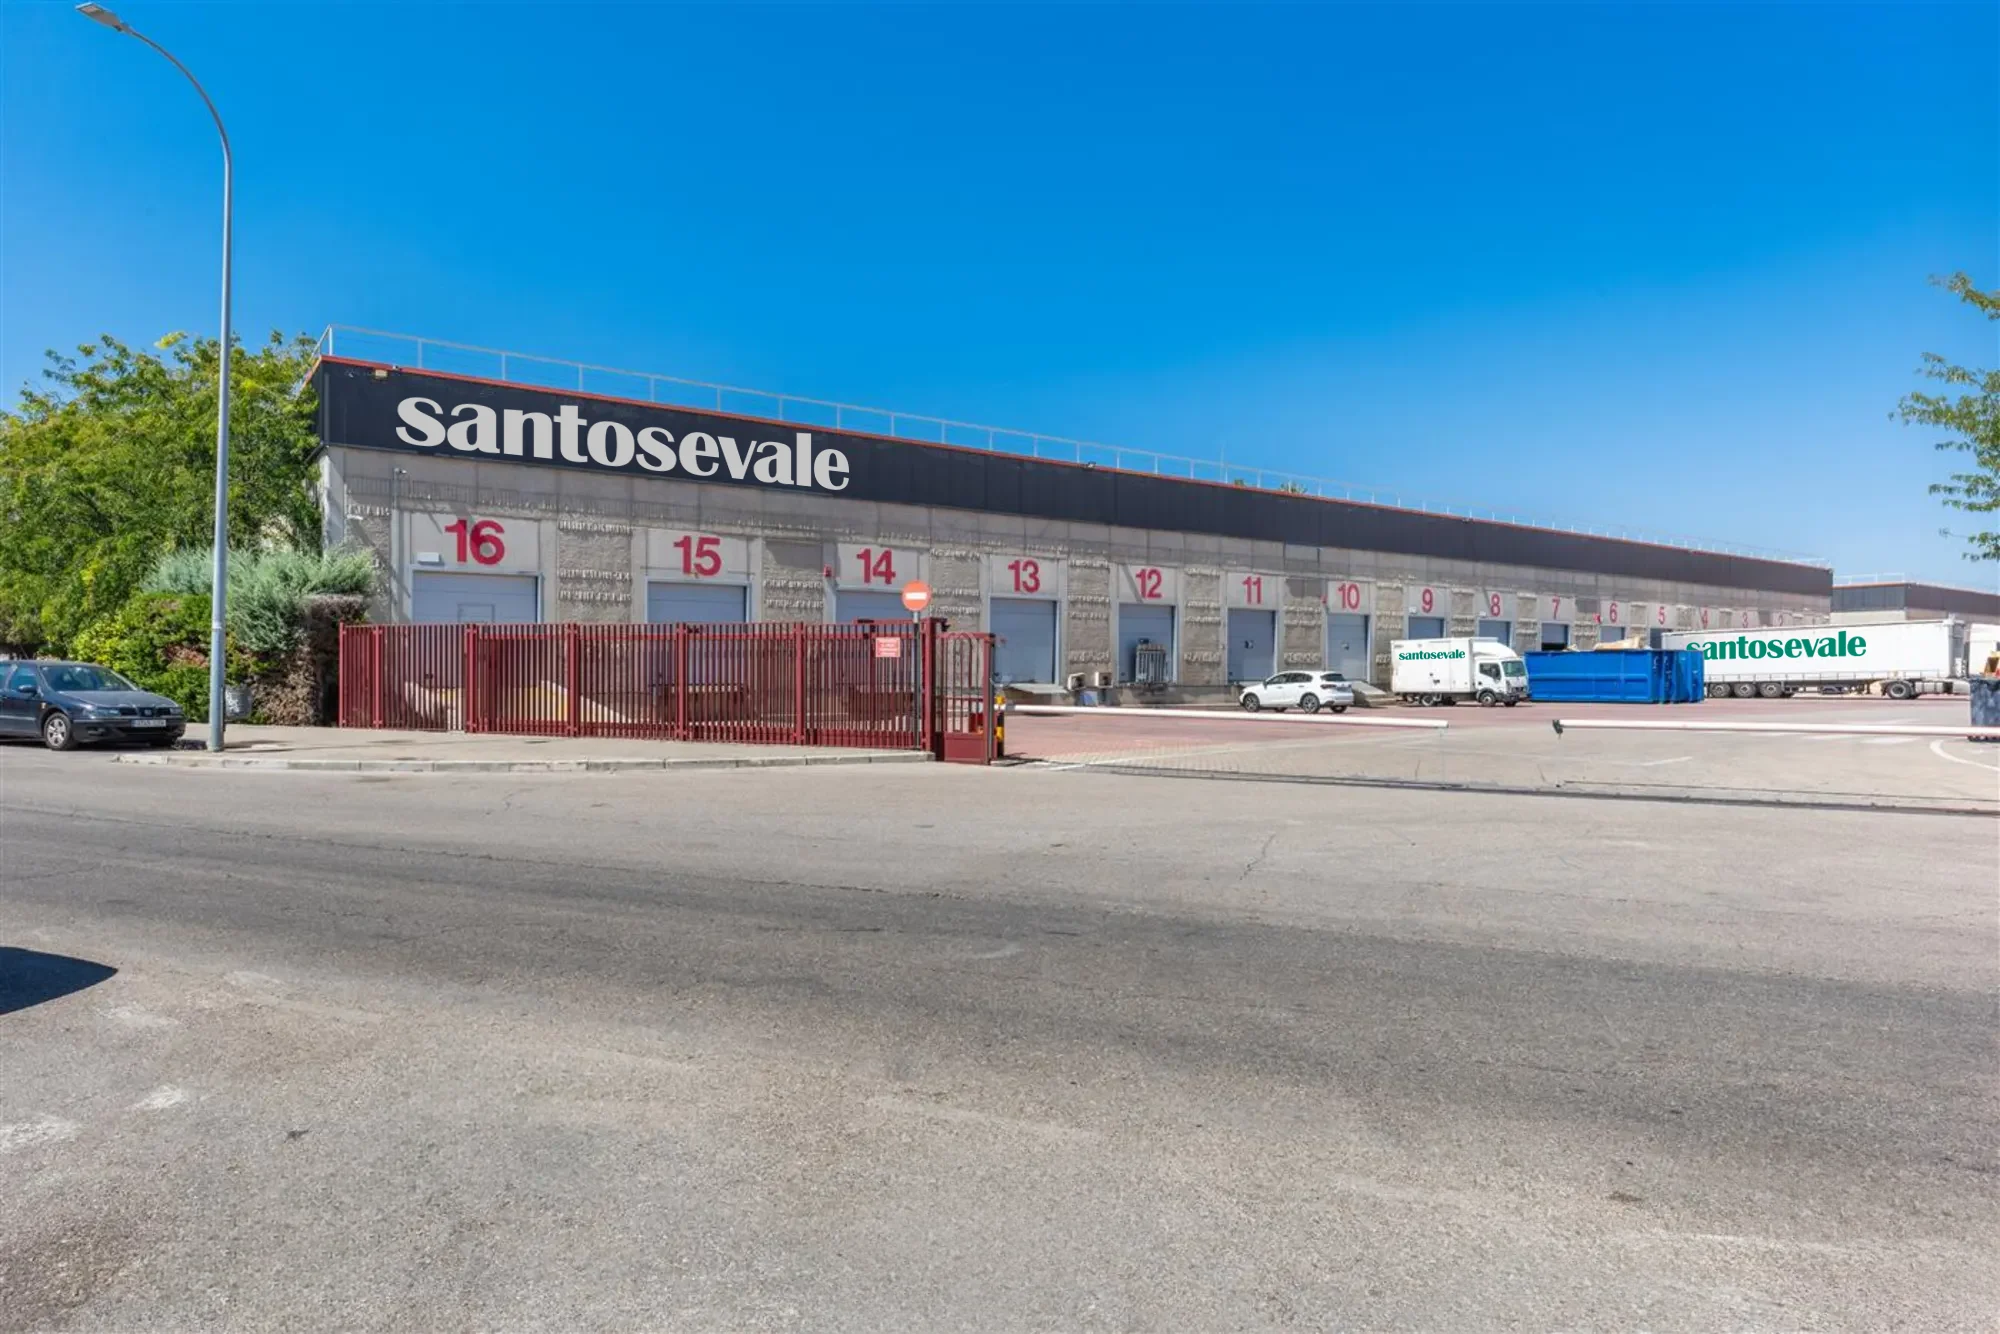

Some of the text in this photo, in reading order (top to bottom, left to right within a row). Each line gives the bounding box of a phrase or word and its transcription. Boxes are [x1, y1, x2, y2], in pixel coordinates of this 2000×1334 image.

[396, 397, 850, 491] santosevale
[444, 519, 506, 566] 16
[673, 536, 722, 577] 15
[856, 548, 896, 585] 14
[1008, 559, 1041, 594] 13
[1135, 568, 1163, 599] 12
[1243, 576, 1263, 604] 11
[1337, 583, 1360, 610] 10
[1421, 588, 1434, 613] 9
[1490, 593, 1501, 616] 8
[1552, 598, 1561, 620] 7
[1609, 602, 1618, 623] 6
[1658, 606, 1666, 625] 5
[1398, 649, 1466, 661] santosevale
